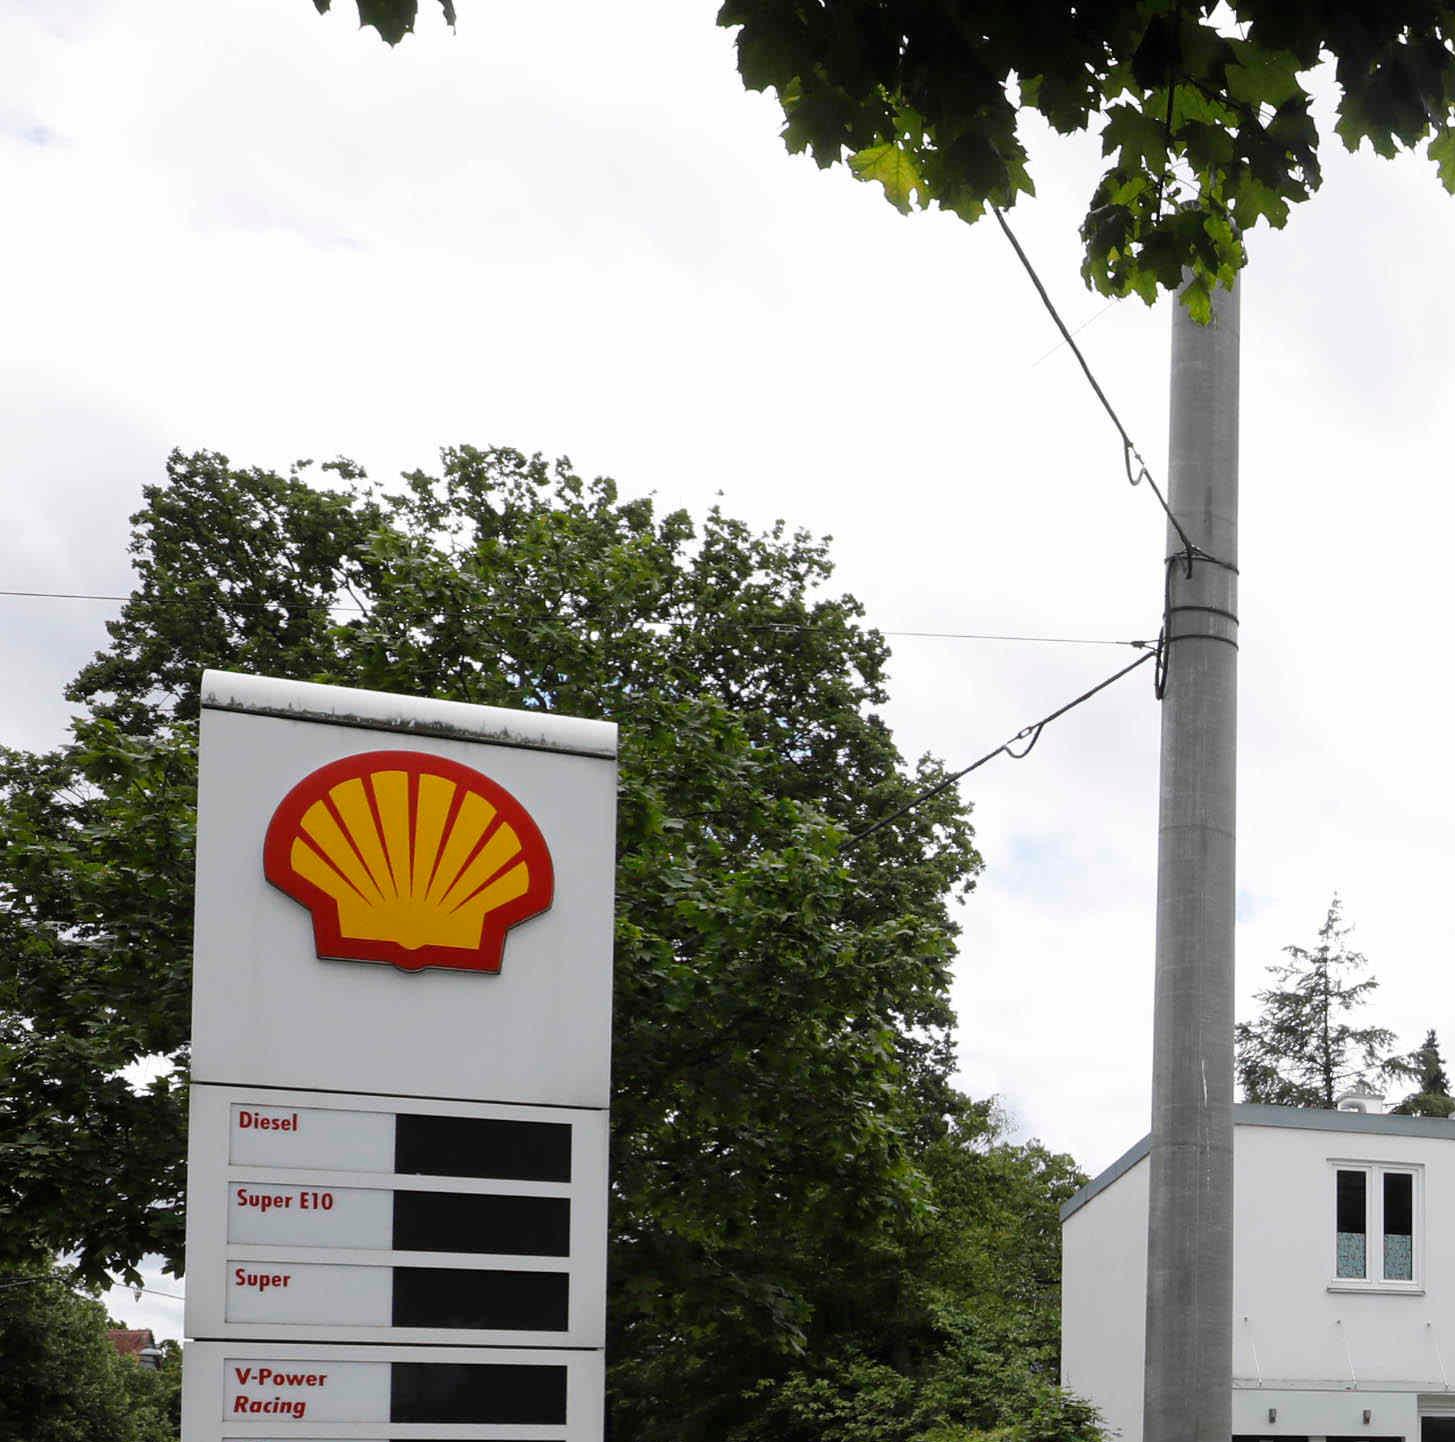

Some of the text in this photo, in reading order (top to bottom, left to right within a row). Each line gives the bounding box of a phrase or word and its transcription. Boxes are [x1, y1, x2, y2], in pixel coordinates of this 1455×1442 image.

[239, 1111, 298, 1131] Diesel
[237, 1189, 333, 1212] Super E10
[235, 1269, 290, 1291] Super
[235, 1367, 328, 1387] V-Power
[233, 1396, 306, 1419] Racing
